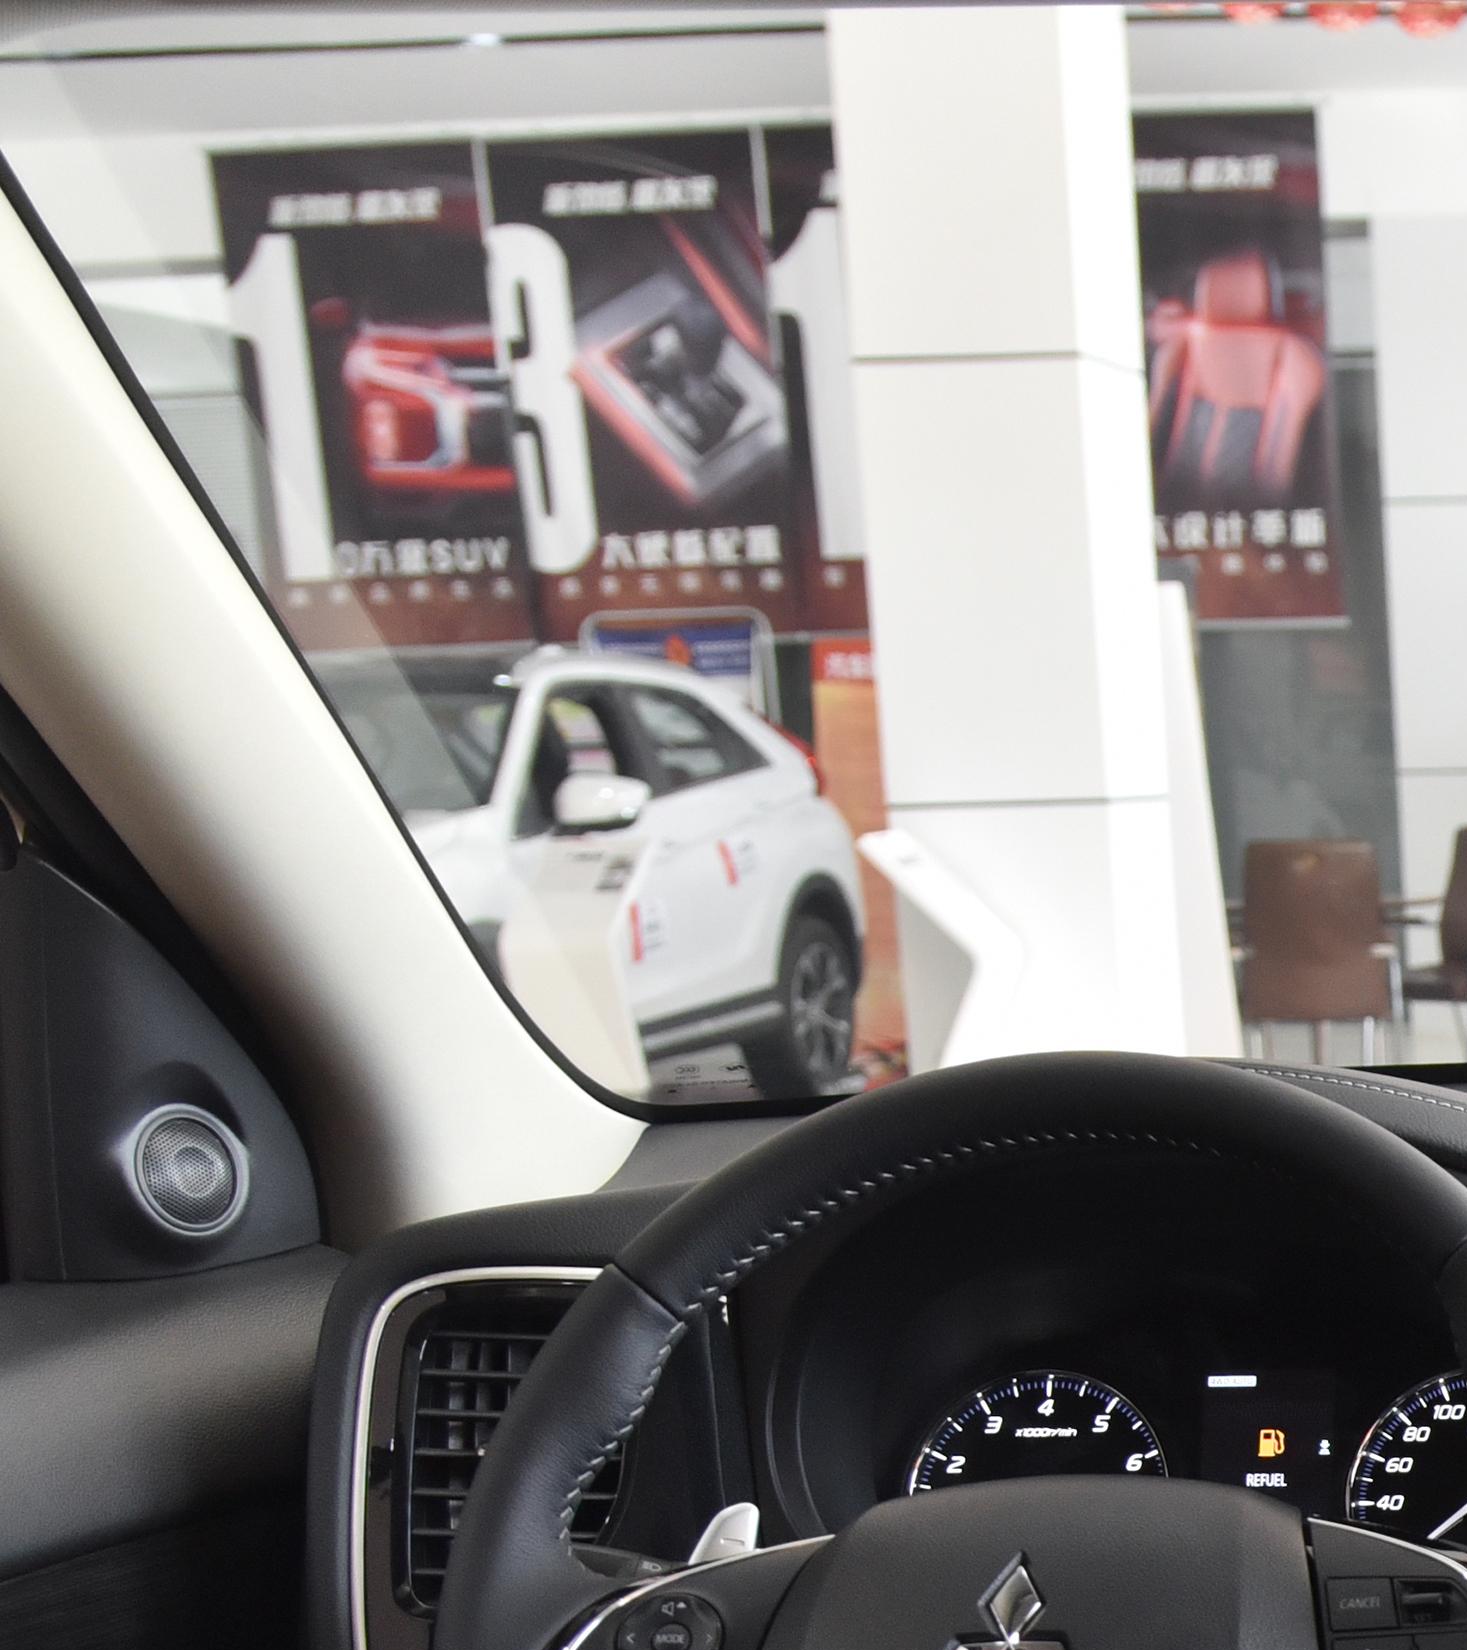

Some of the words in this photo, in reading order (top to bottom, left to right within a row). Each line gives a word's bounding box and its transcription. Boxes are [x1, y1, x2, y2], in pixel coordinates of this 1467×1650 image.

[1038, 1399, 1055, 1416] 4
[1433, 1404, 1466, 1420] 100
[984, 1416, 1003, 1434] 3
[1092, 1414, 1111, 1433] 5
[1402, 1426, 1431, 1442] 80
[946, 1455, 966, 1474] 2
[1126, 1453, 1143, 1471] 6
[1385, 1457, 1413, 1473] 60
[1245, 1472, 1288, 1487] REFUEL
[1376, 1494, 1405, 1511] 40
[1338, 1595, 1381, 1610] CANCEL
[655, 1633, 685, 1644] MODE
